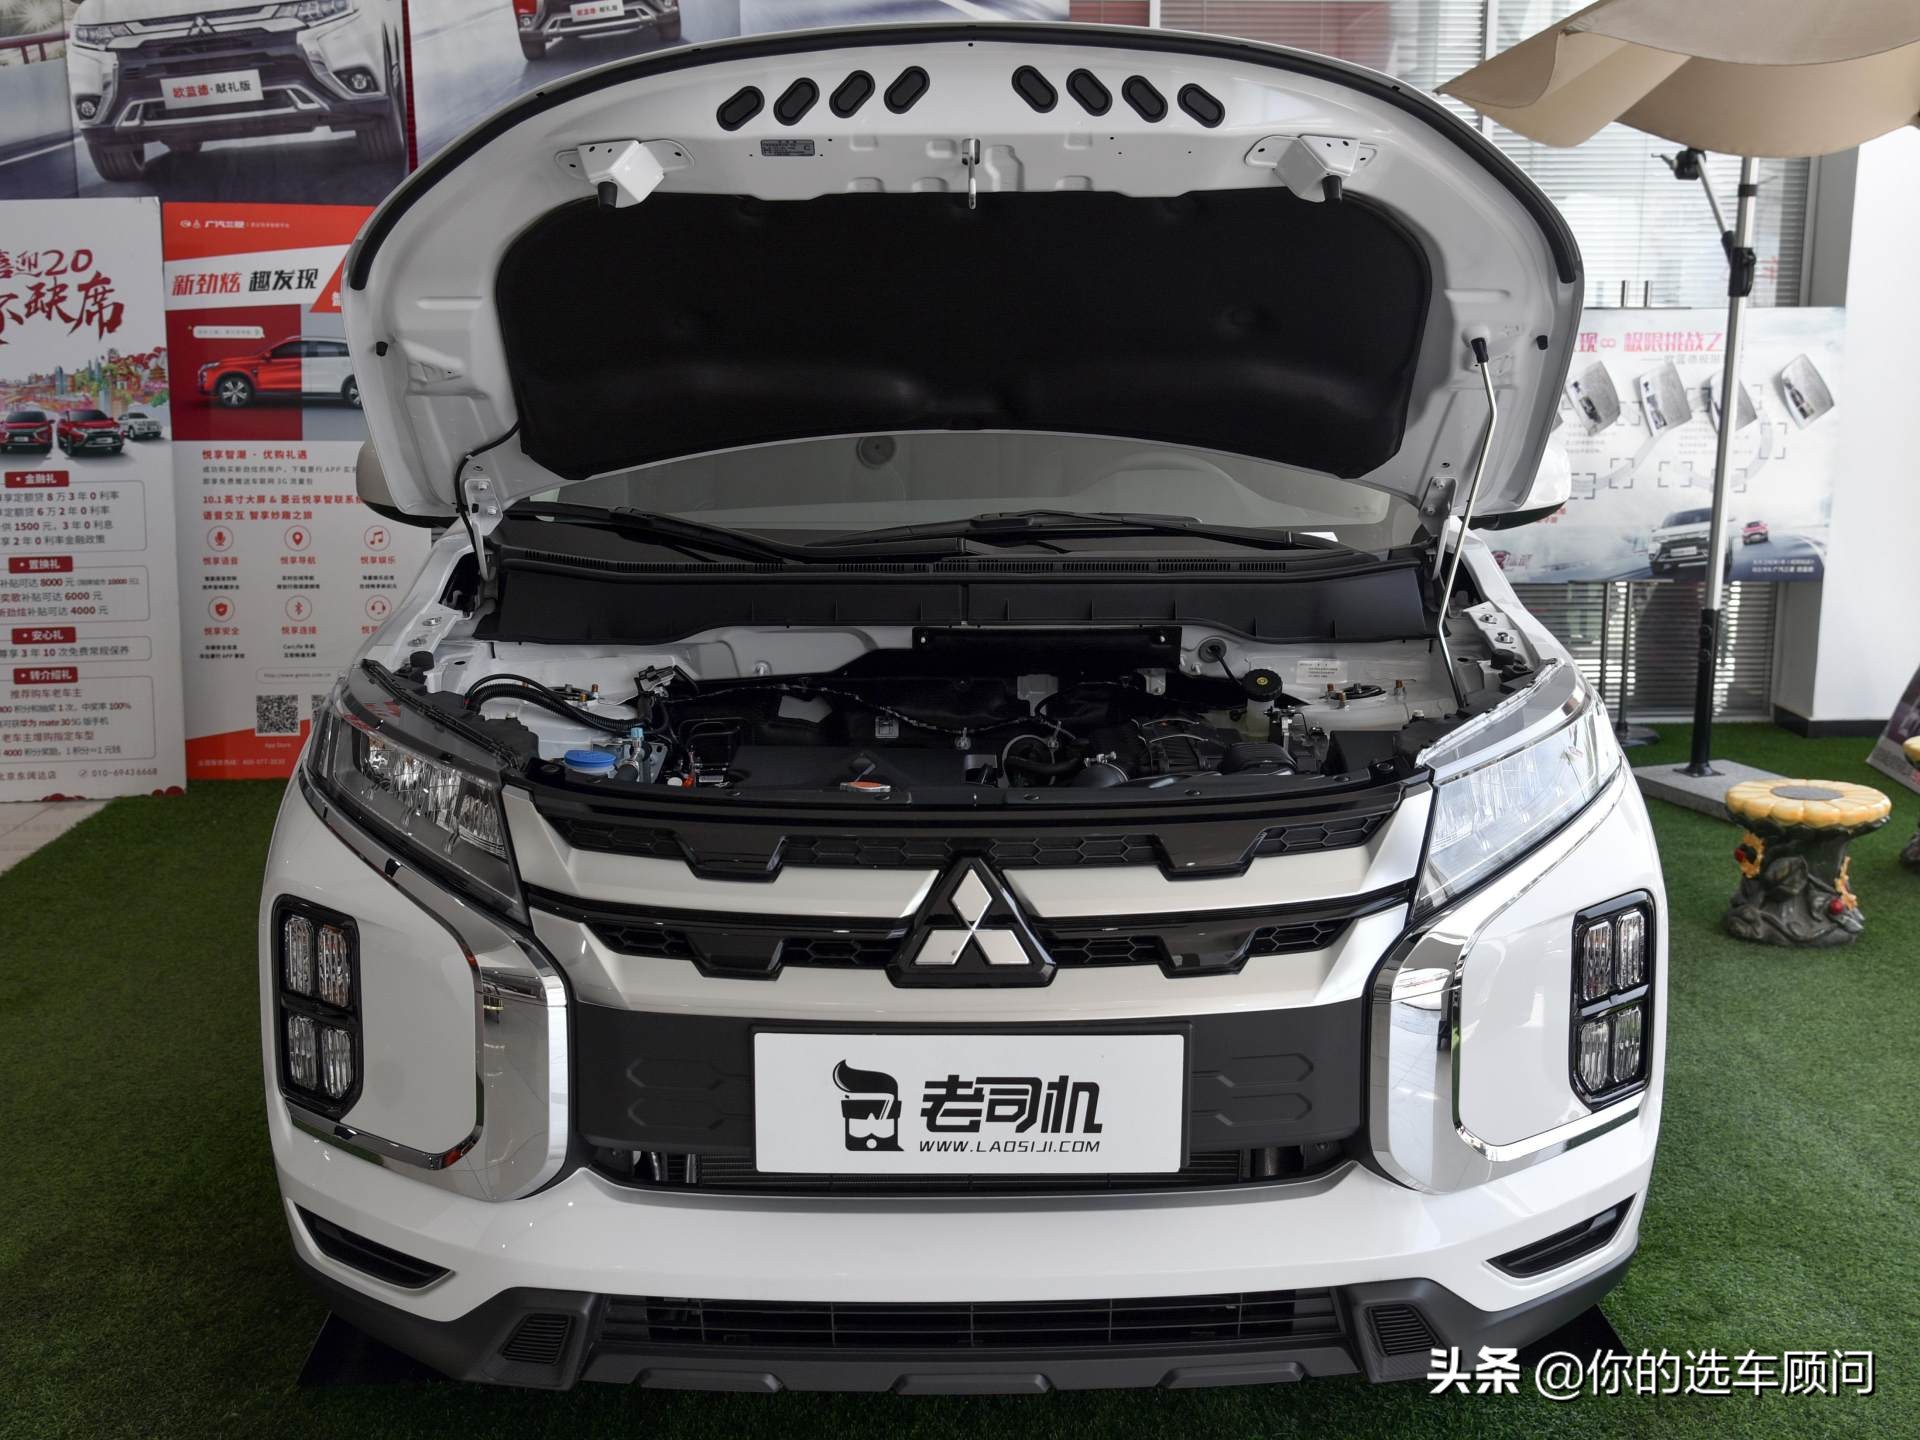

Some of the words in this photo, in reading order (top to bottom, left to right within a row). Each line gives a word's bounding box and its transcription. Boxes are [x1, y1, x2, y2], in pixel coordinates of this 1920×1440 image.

[172, 271, 242, 297] 新劲炫
[248, 268, 319, 292] 趣发现
[25, 473, 57, 485] 金融礼
[0, 492, 44, 503] 享定额贷
[0, 507, 35, 518] 定额贷
[14, 522, 40, 532] 1500
[64, 591, 90, 601] 6000
[70, 606, 96, 615] 4000
[31, 630, 65, 641] 安心礼
[919, 1074, 1104, 1134] 老司机
[919, 1140, 1101, 1154] WWW.LAOSIJI.COM
